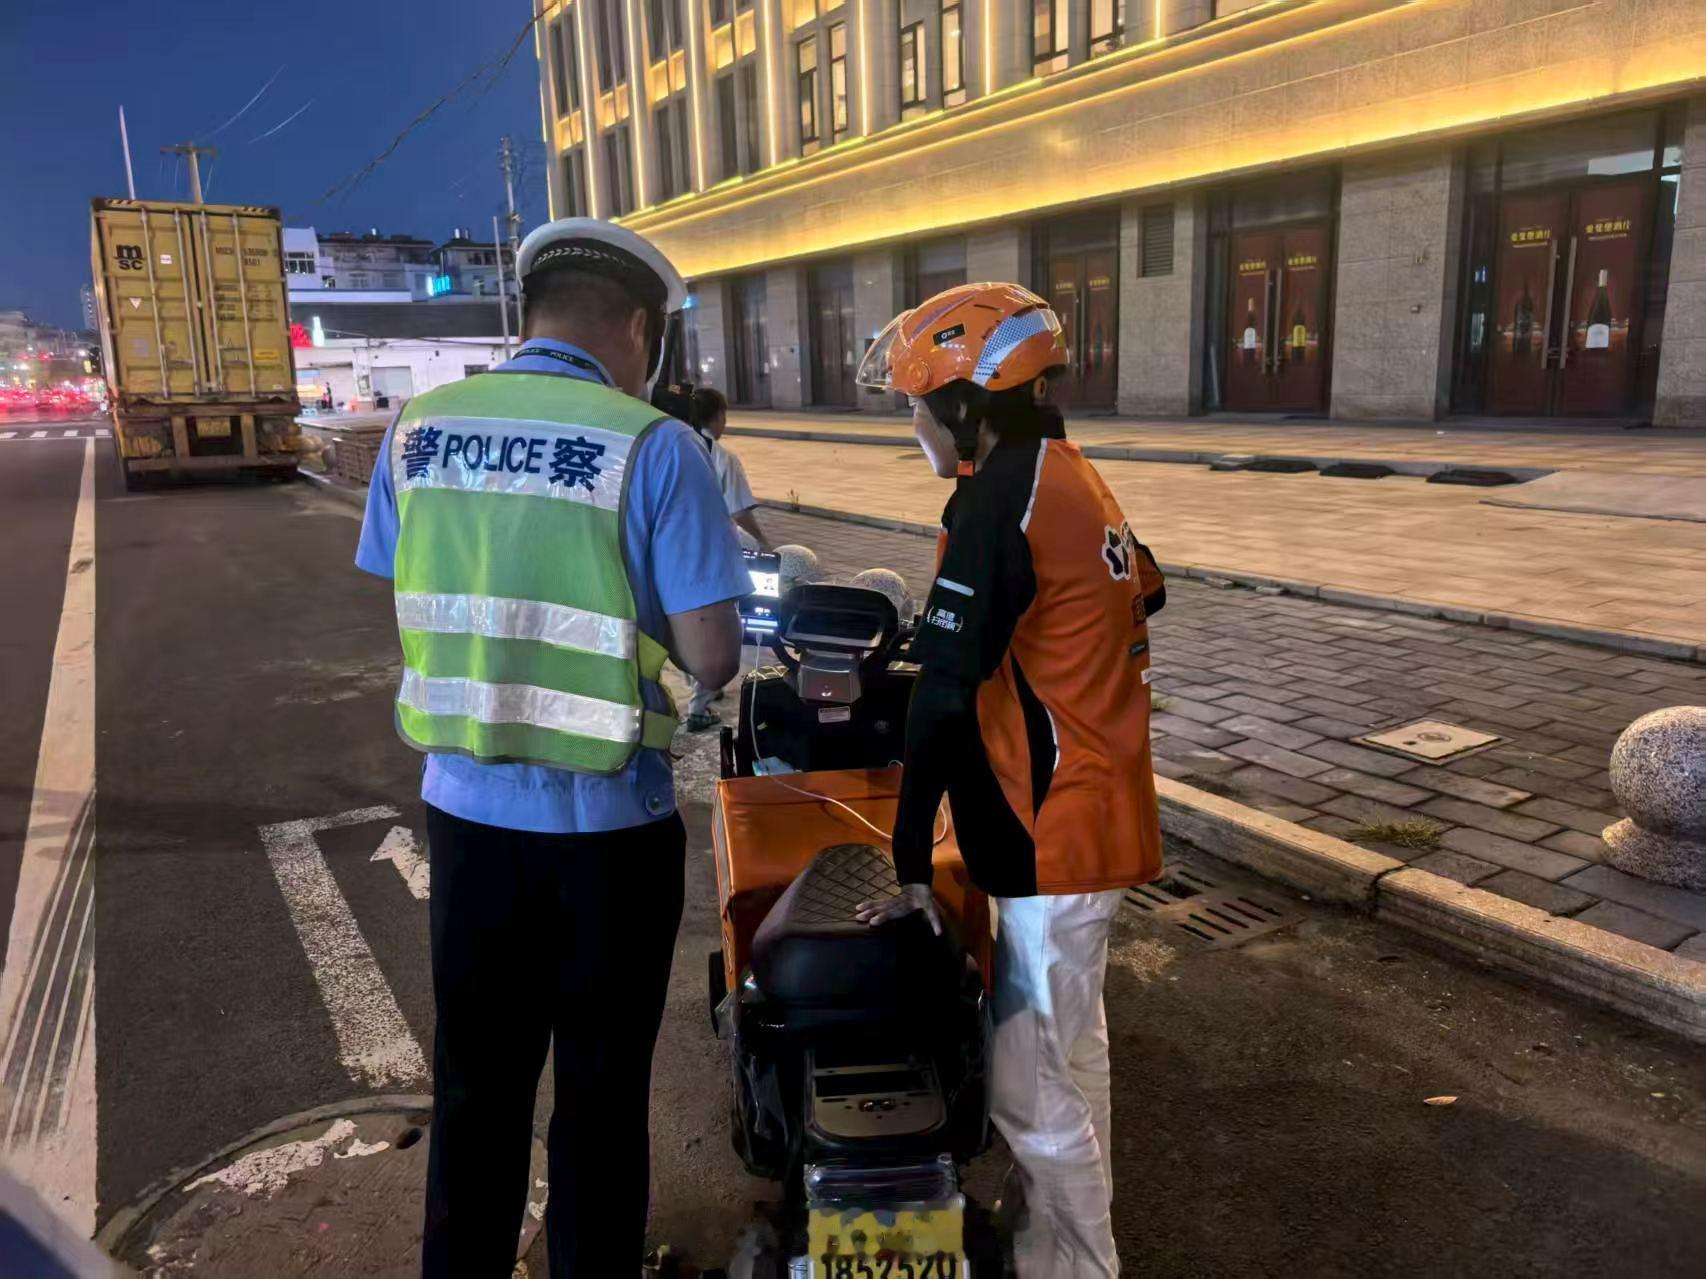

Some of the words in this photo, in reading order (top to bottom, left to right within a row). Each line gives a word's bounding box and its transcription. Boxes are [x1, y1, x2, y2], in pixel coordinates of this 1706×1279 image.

[550, 351, 575, 362] POLICE
[401, 426, 442, 481] 警
[442, 434, 547, 474] POLICE
[548, 436, 606, 492] 察
